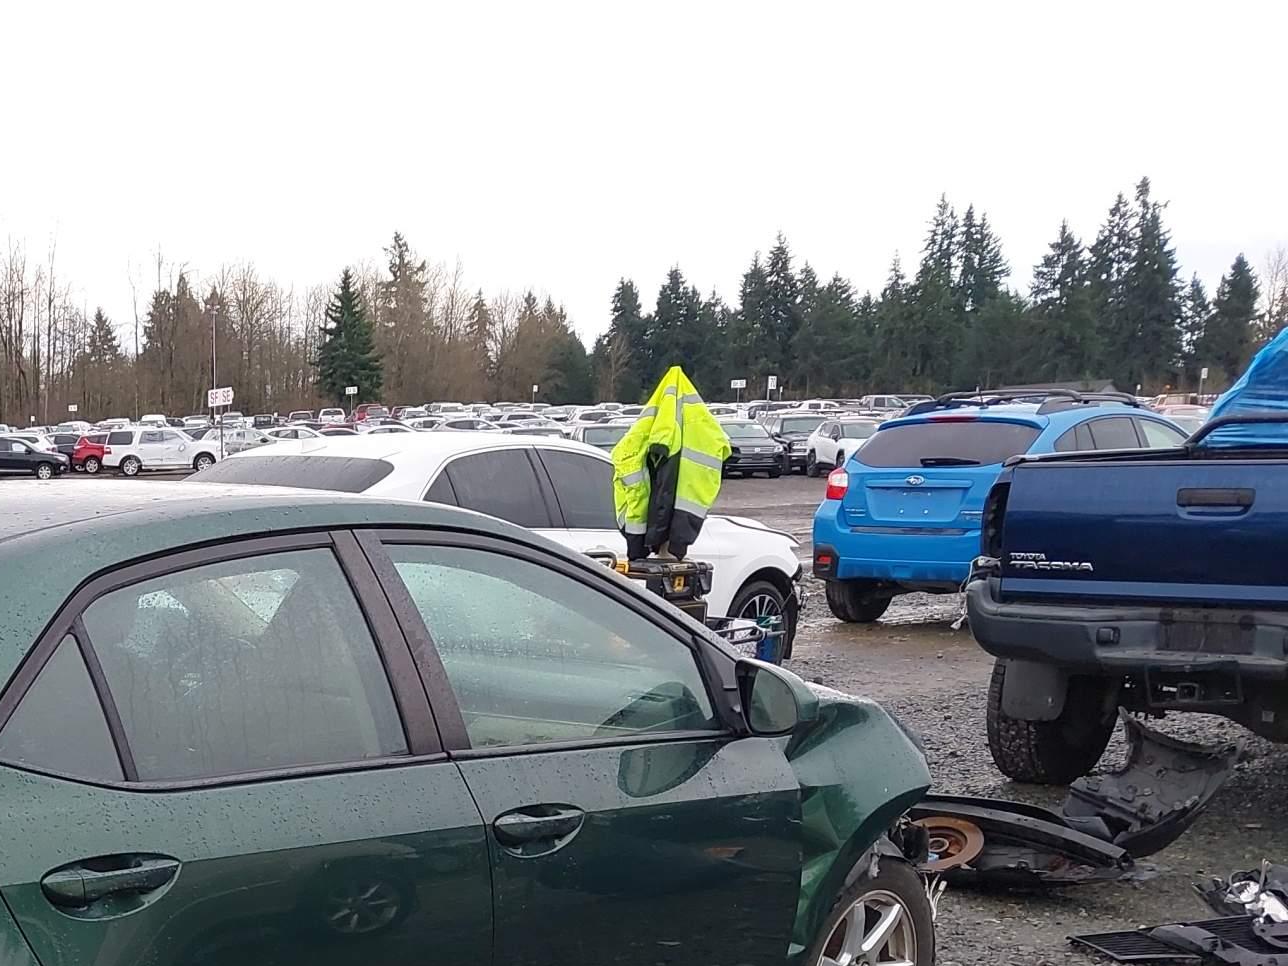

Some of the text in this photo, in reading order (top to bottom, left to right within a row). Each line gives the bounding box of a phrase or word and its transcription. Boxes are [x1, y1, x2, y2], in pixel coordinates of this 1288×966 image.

[210, 390, 231, 404] SF SE
[1009, 552, 1047, 560] TOYOTA
[1009, 561, 1094, 572] TACOMA
